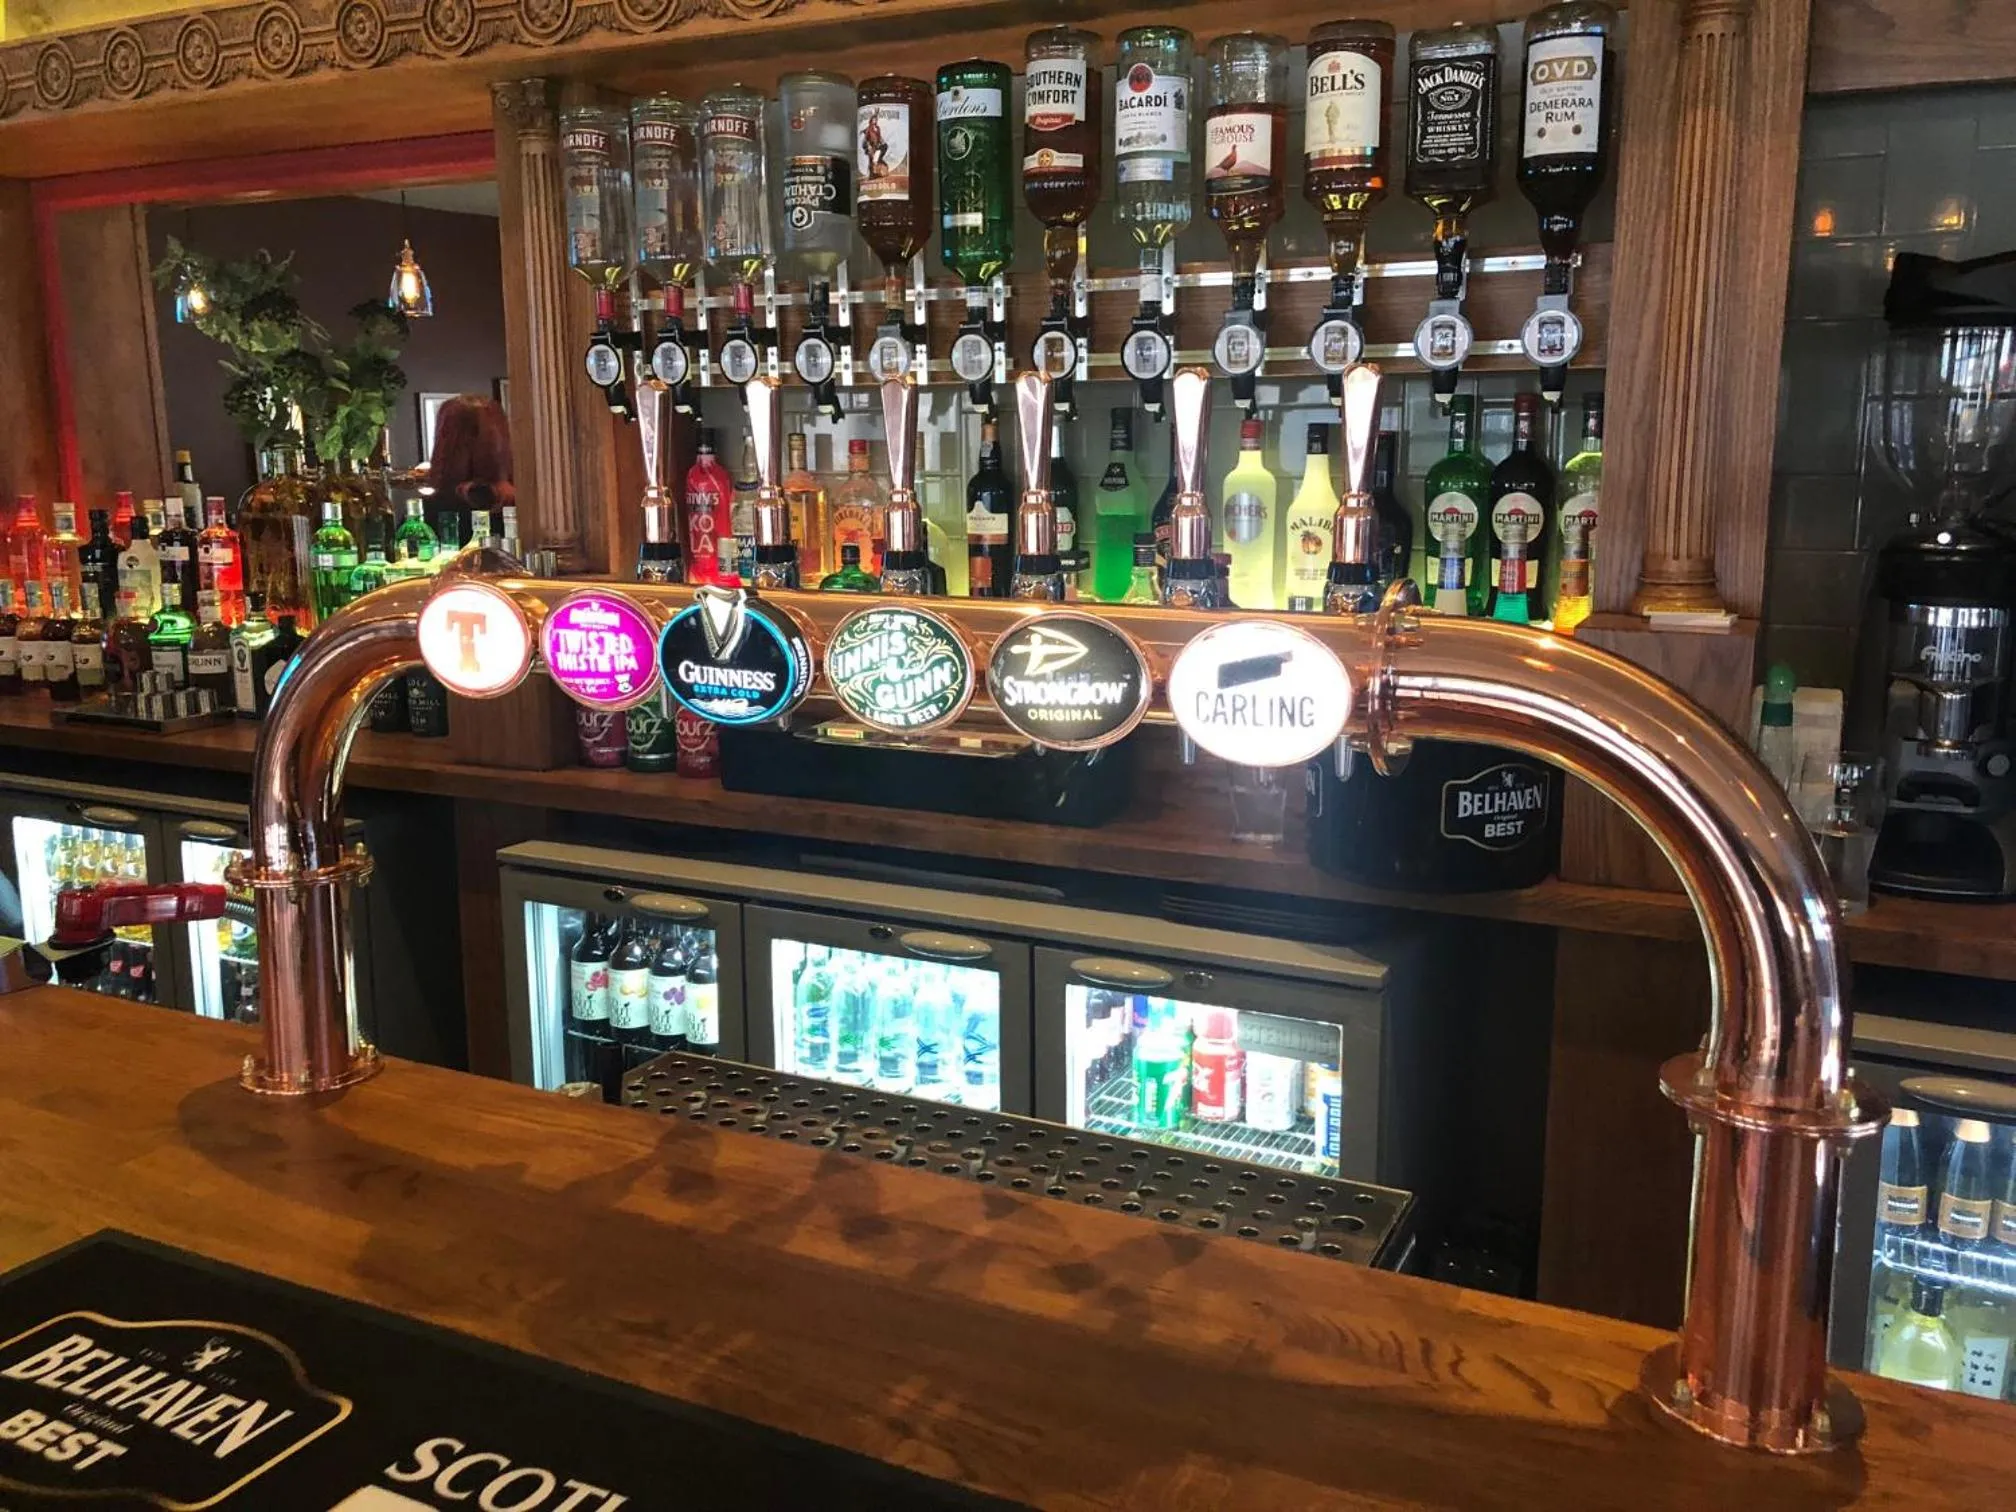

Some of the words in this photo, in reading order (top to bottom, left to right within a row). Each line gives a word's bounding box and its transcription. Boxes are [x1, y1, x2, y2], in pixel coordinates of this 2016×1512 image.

[1024, 70, 1083, 91] SOUTHERN
[1309, 69, 1366, 97] BELL'S
[1417, 71, 1444, 94] JACK
[1444, 66, 1486, 90] DANIEL'S
[1027, 89, 1077, 107] COMFORT
[1529, 97, 1594, 114] DEMERARA
[1545, 111, 1576, 124] RUM
[1215, 124, 1256, 137] FAMOUS
[1290, 516, 1334, 536] MALIB
[1432, 513, 1474, 524] MARTINI
[1495, 513, 1540, 525] MARTINI
[445, 609, 487, 673] T
[838, 631, 907, 680] INNIS
[678, 660, 776, 691] GUINNESS
[875, 661, 953, 709] GUNN
[693, 684, 727, 696] EXTRA
[730, 688, 760, 699] COLD
[1003, 675, 1126, 707] STRONGBOW
[907, 703, 941, 724] BEER
[1027, 707, 1103, 721] ORIGINAL
[1195, 690, 1315, 728] CARLING
[1457, 783, 1543, 818] BELHAVEN
[1484, 820, 1525, 838] BEST
[0, 1333, 295, 1459] BELHAVEN
[0, 1408, 129, 1472] BEST
